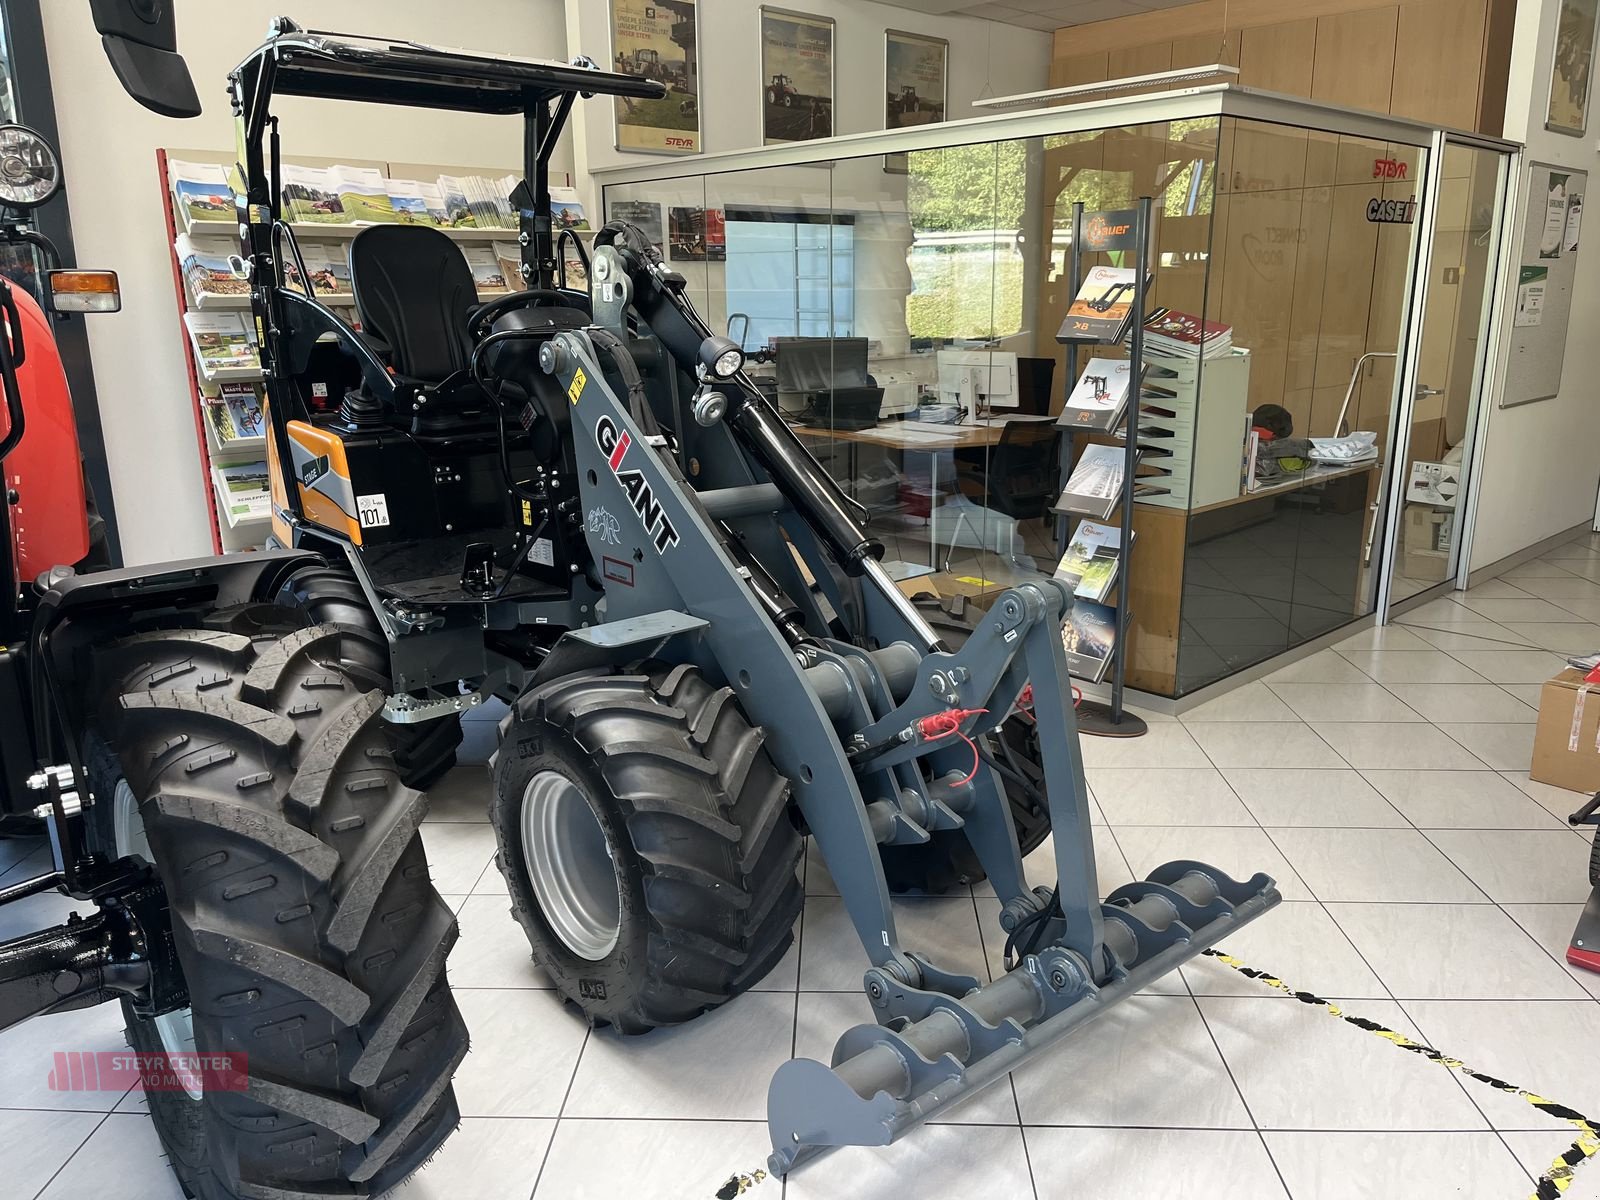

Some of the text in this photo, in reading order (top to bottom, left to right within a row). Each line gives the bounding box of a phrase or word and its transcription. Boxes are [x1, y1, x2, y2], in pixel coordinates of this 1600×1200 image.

[665, 138, 693, 147] STEYR
[1373, 159, 1408, 179] STEYR
[304, 468, 318, 485] STAGE
[361, 508, 380, 525] 101
